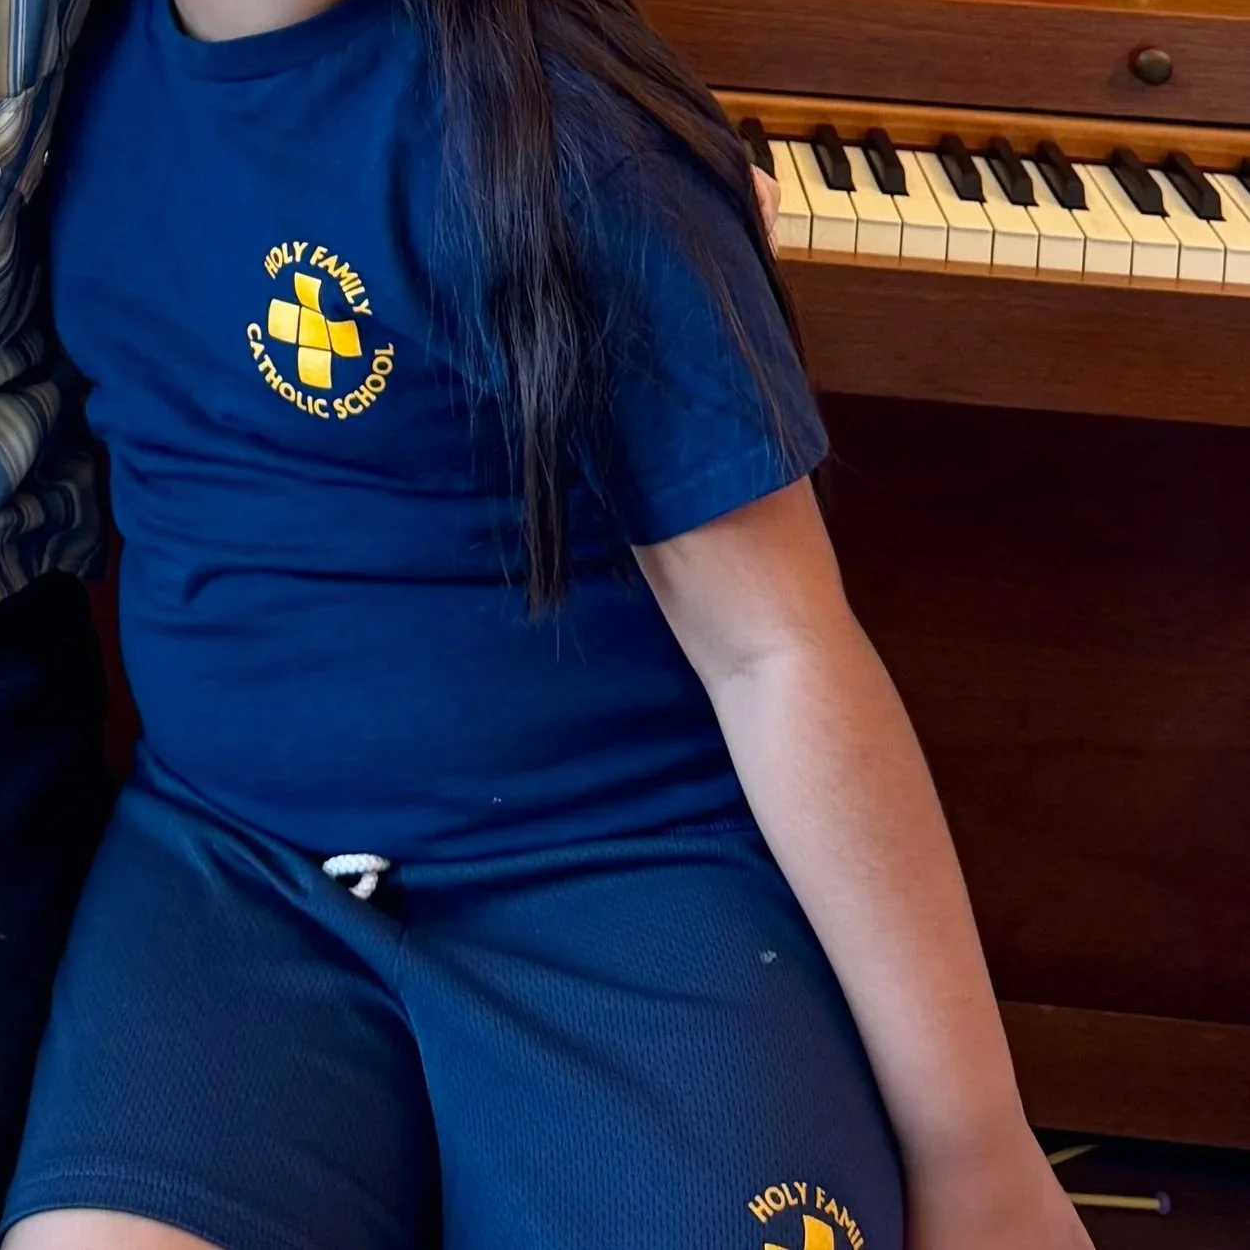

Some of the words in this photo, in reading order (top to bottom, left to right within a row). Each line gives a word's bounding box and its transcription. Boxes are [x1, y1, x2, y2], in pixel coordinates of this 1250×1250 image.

[264, 241, 308, 279] HOLY
[309, 246, 372, 315] FAMILY
[247, 323, 329, 418] CATHOLIC
[333, 343, 394, 419] SCHOOL
[748, 1181, 807, 1223] HOLY
